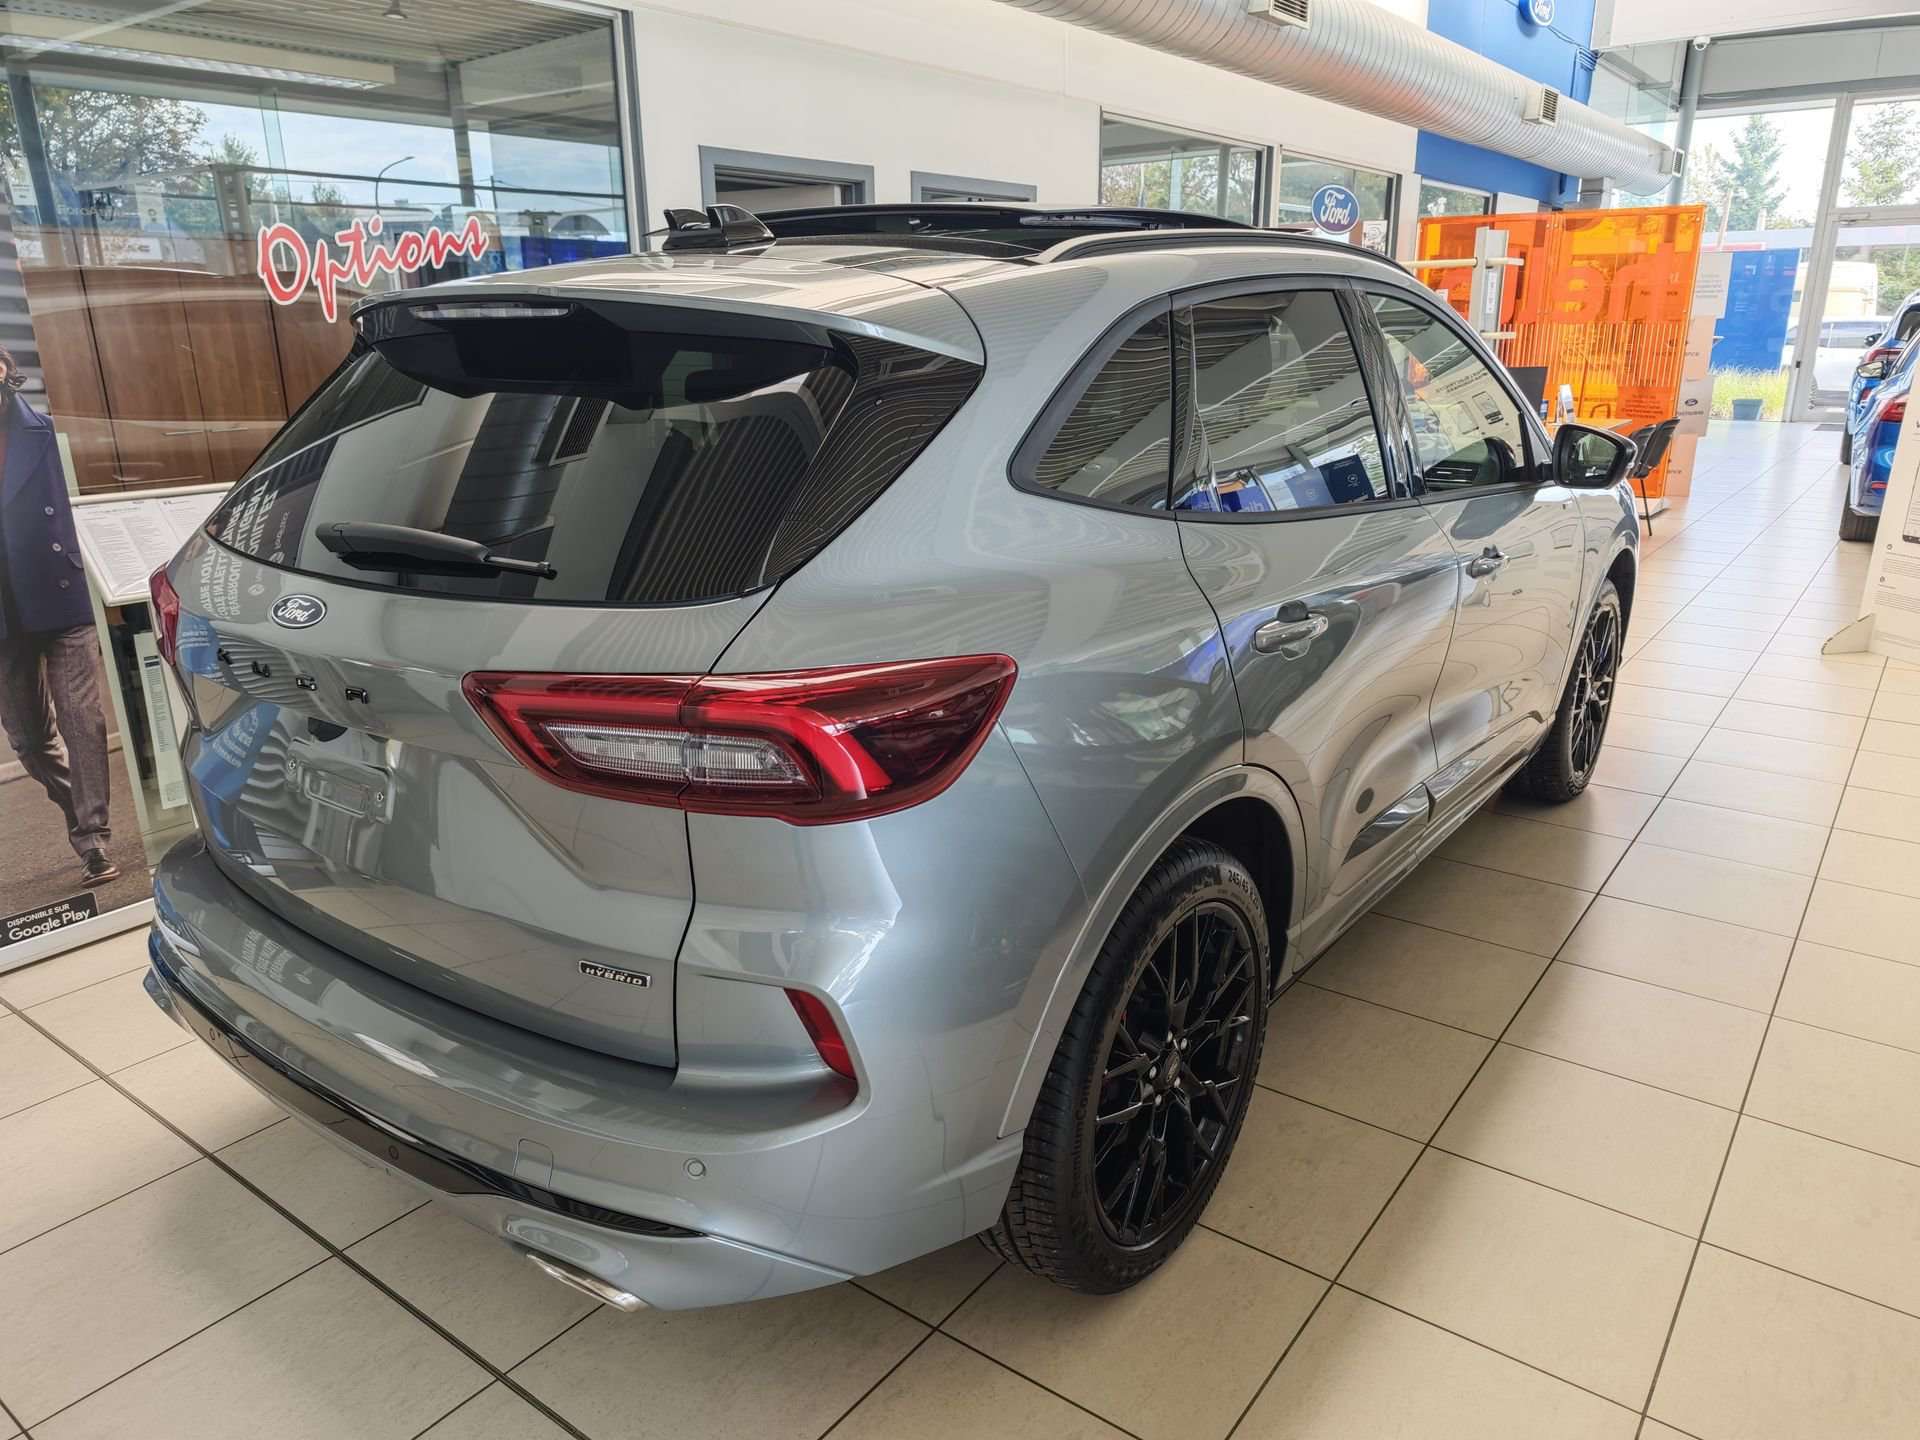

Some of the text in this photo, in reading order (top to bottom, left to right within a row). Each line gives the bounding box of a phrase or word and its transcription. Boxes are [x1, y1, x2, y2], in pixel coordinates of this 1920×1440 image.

[1320, 189, 1352, 225] Ford
[257, 214, 489, 323] Options
[278, 598, 315, 622] Ford
[7, 903, 70, 928] DISPONIBLE SUR
[9, 909, 90, 940] Google Play
[585, 967, 643, 985] HYBRID
